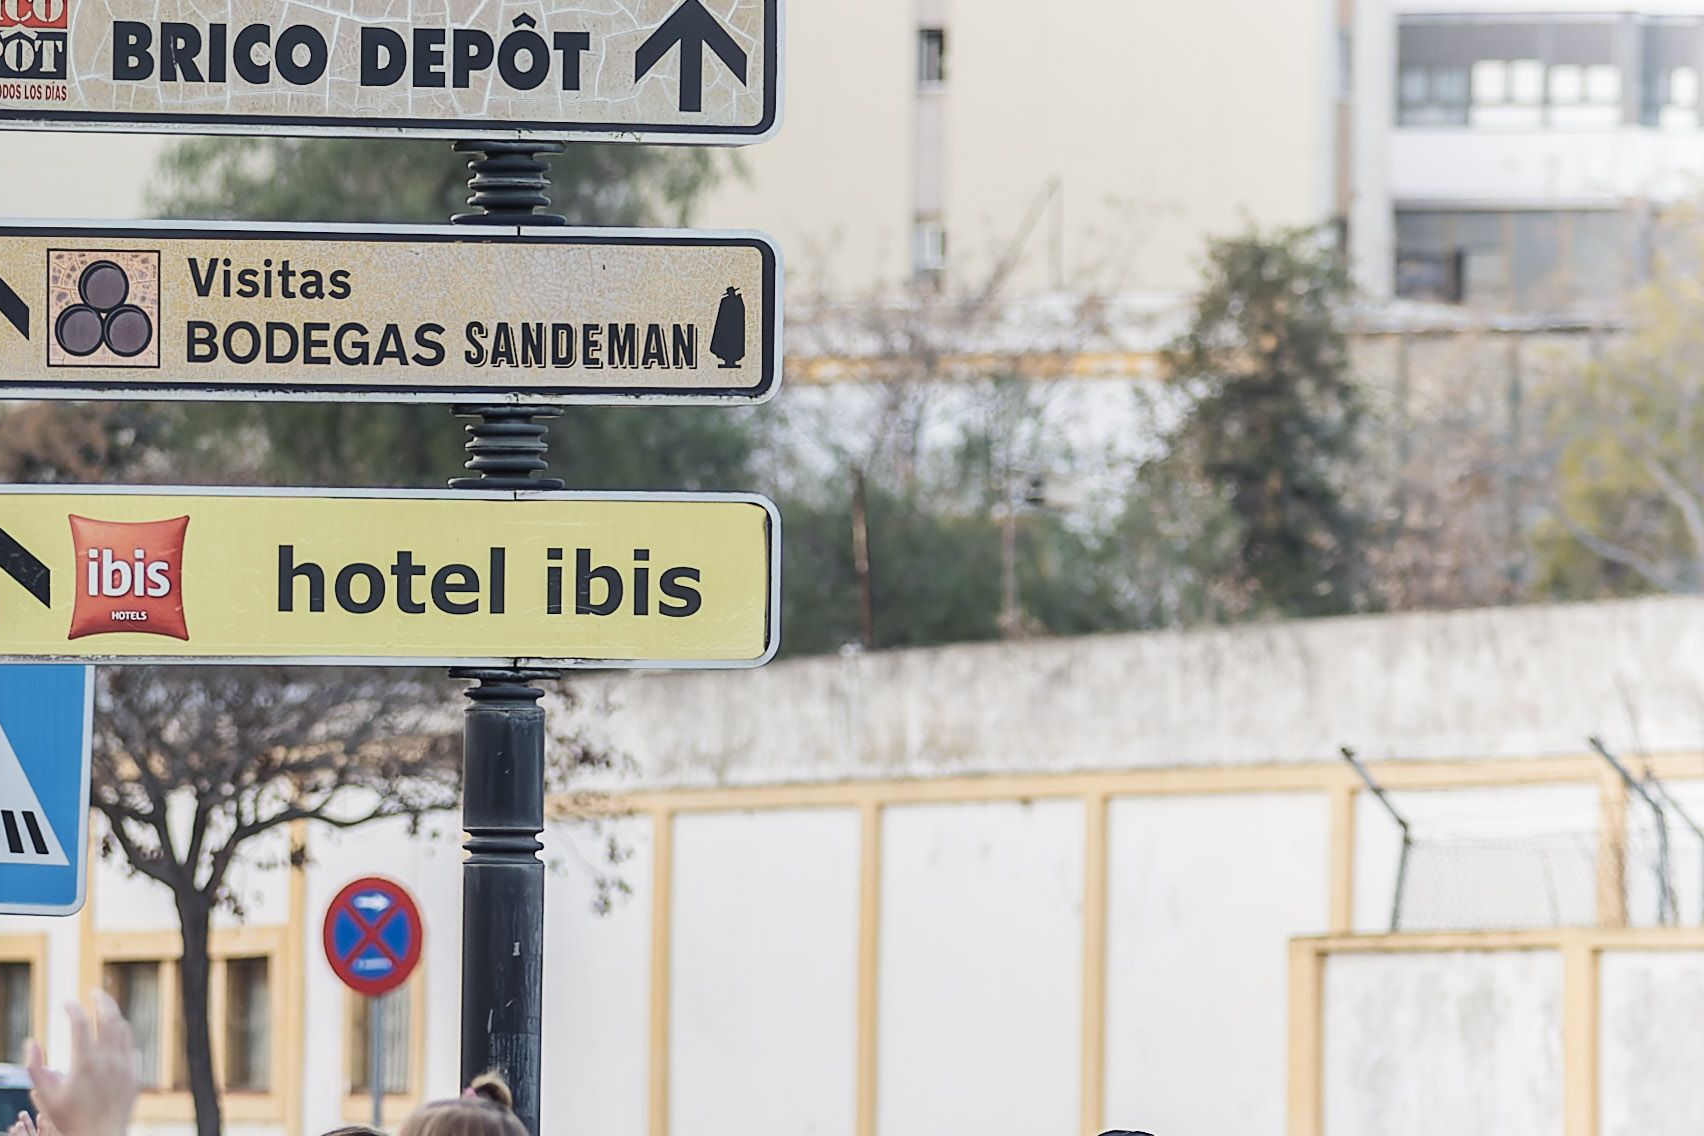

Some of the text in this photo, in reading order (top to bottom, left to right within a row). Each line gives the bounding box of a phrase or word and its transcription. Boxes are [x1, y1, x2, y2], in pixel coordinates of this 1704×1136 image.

[112, 12, 590, 91] BRICO DEPÔT
[24, 85, 42, 100] LOS
[46, 81, 67, 101] DÍAS
[187, 257, 351, 299] Visitas
[186, 320, 698, 369] BODEGAS SANDEMAN
[88, 548, 171, 597] ibis
[278, 544, 702, 617] hotel ibis
[111, 610, 148, 621] HOTELS
